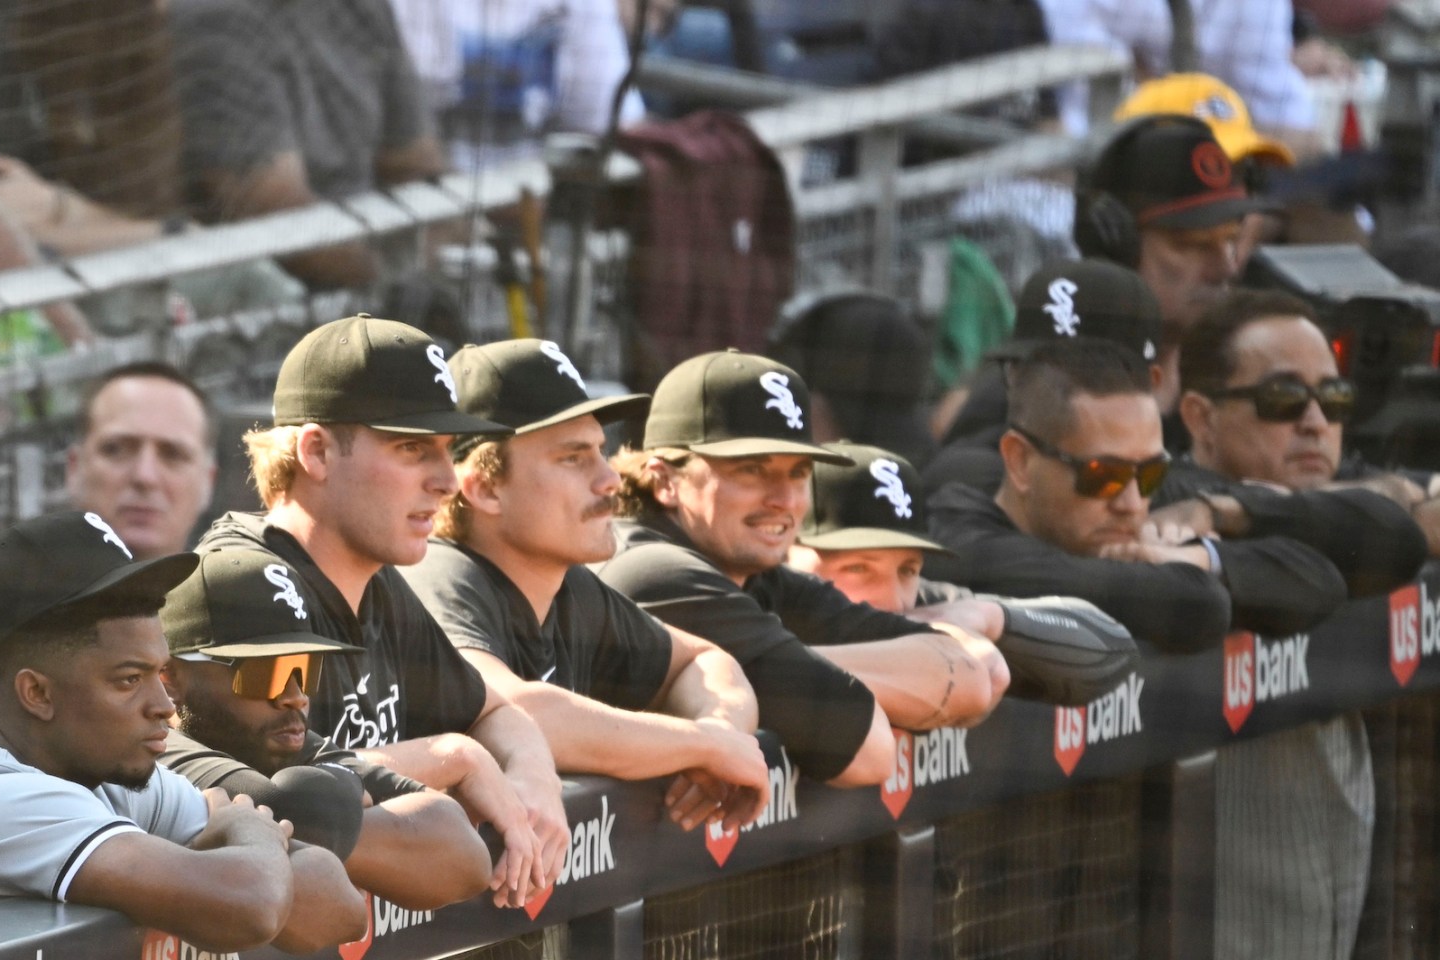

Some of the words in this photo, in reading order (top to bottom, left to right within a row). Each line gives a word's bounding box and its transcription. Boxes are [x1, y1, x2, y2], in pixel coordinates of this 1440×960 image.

[1227, 652, 1253, 711] us
[1255, 633, 1310, 703] bank
[1391, 604, 1418, 663] us
[1058, 705, 1084, 752] us
[1086, 671, 1145, 745] bank
[741, 745, 800, 833] nk
[913, 726, 970, 787] bank
